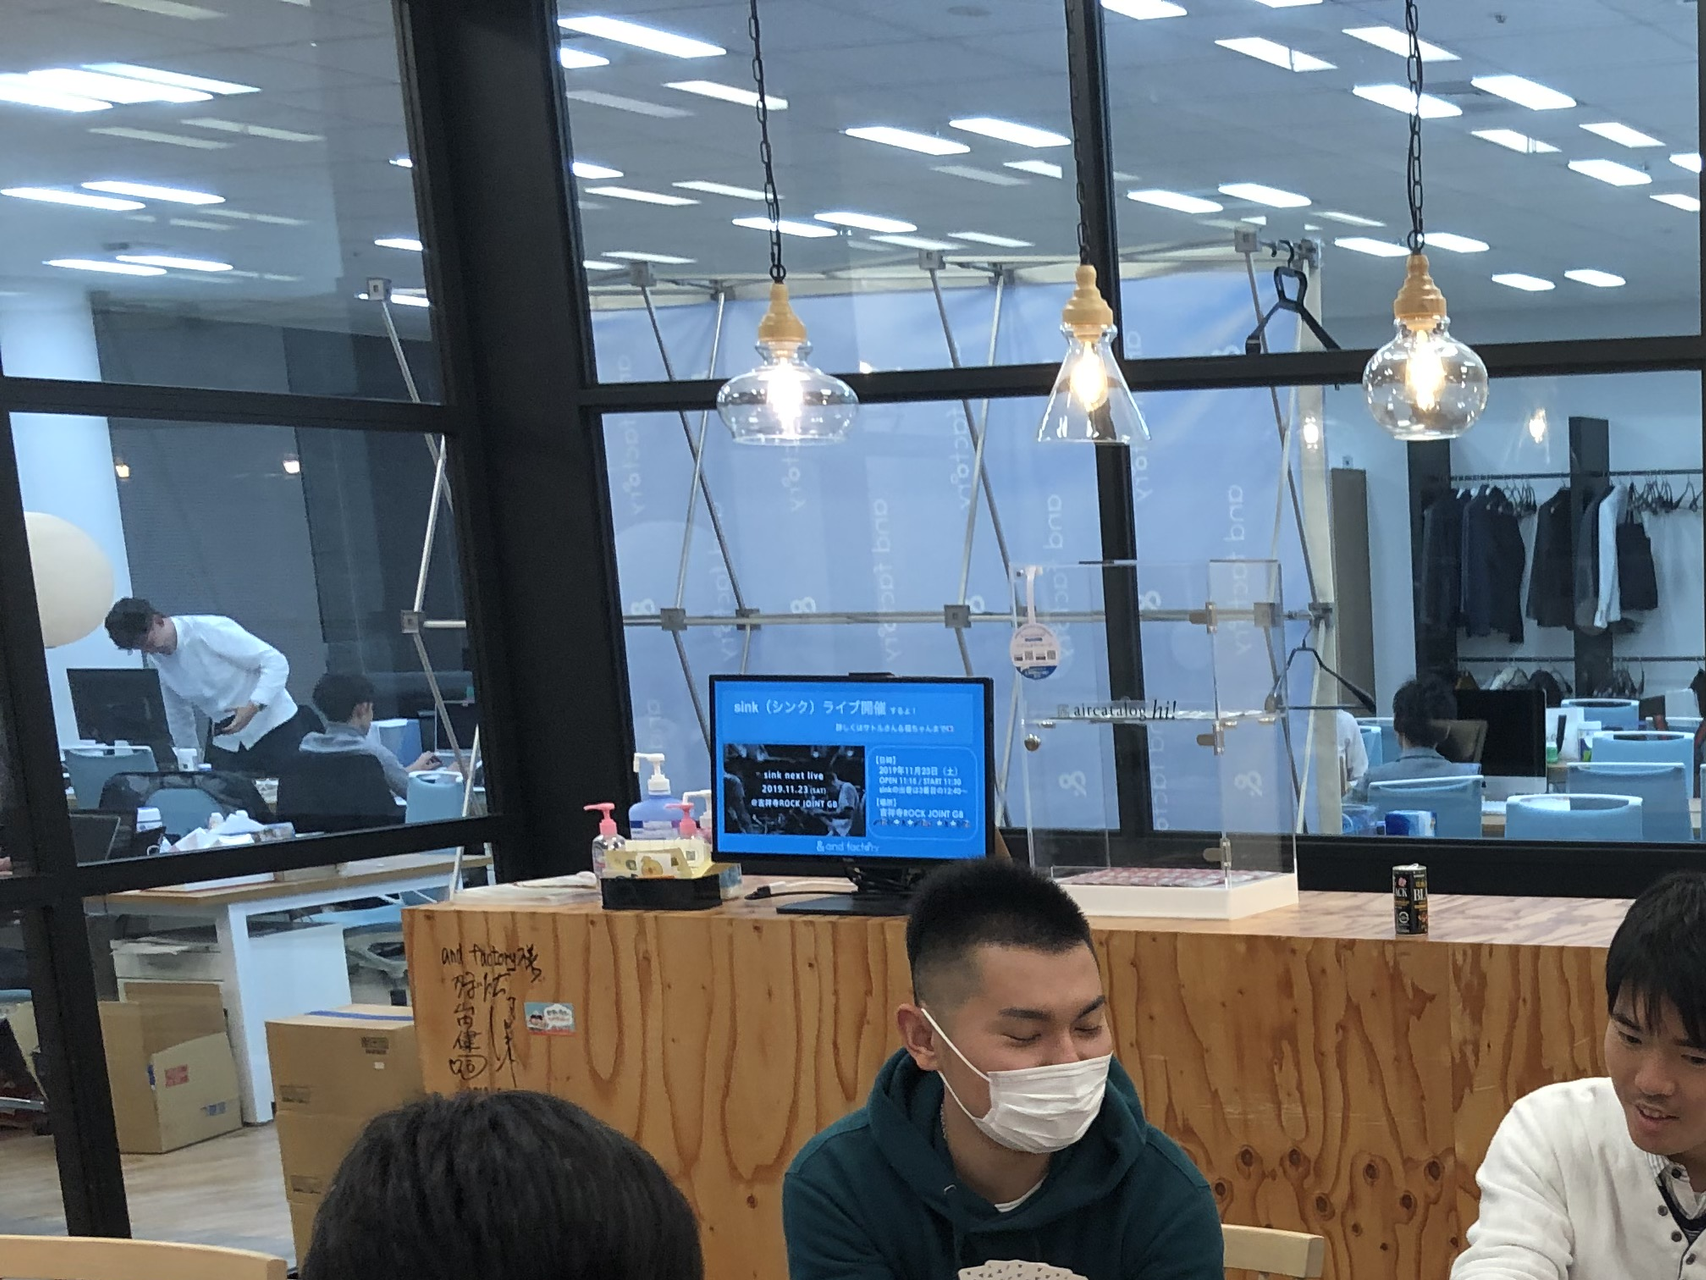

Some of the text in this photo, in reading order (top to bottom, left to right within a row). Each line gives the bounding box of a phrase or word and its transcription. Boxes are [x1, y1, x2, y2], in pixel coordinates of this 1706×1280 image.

[1073, 699, 1177, 721] aircatalog hi!
[763, 770, 824, 781] sink next live
[761, 784, 808, 794] 2019.11.23
[441, 943, 463, 965] and
